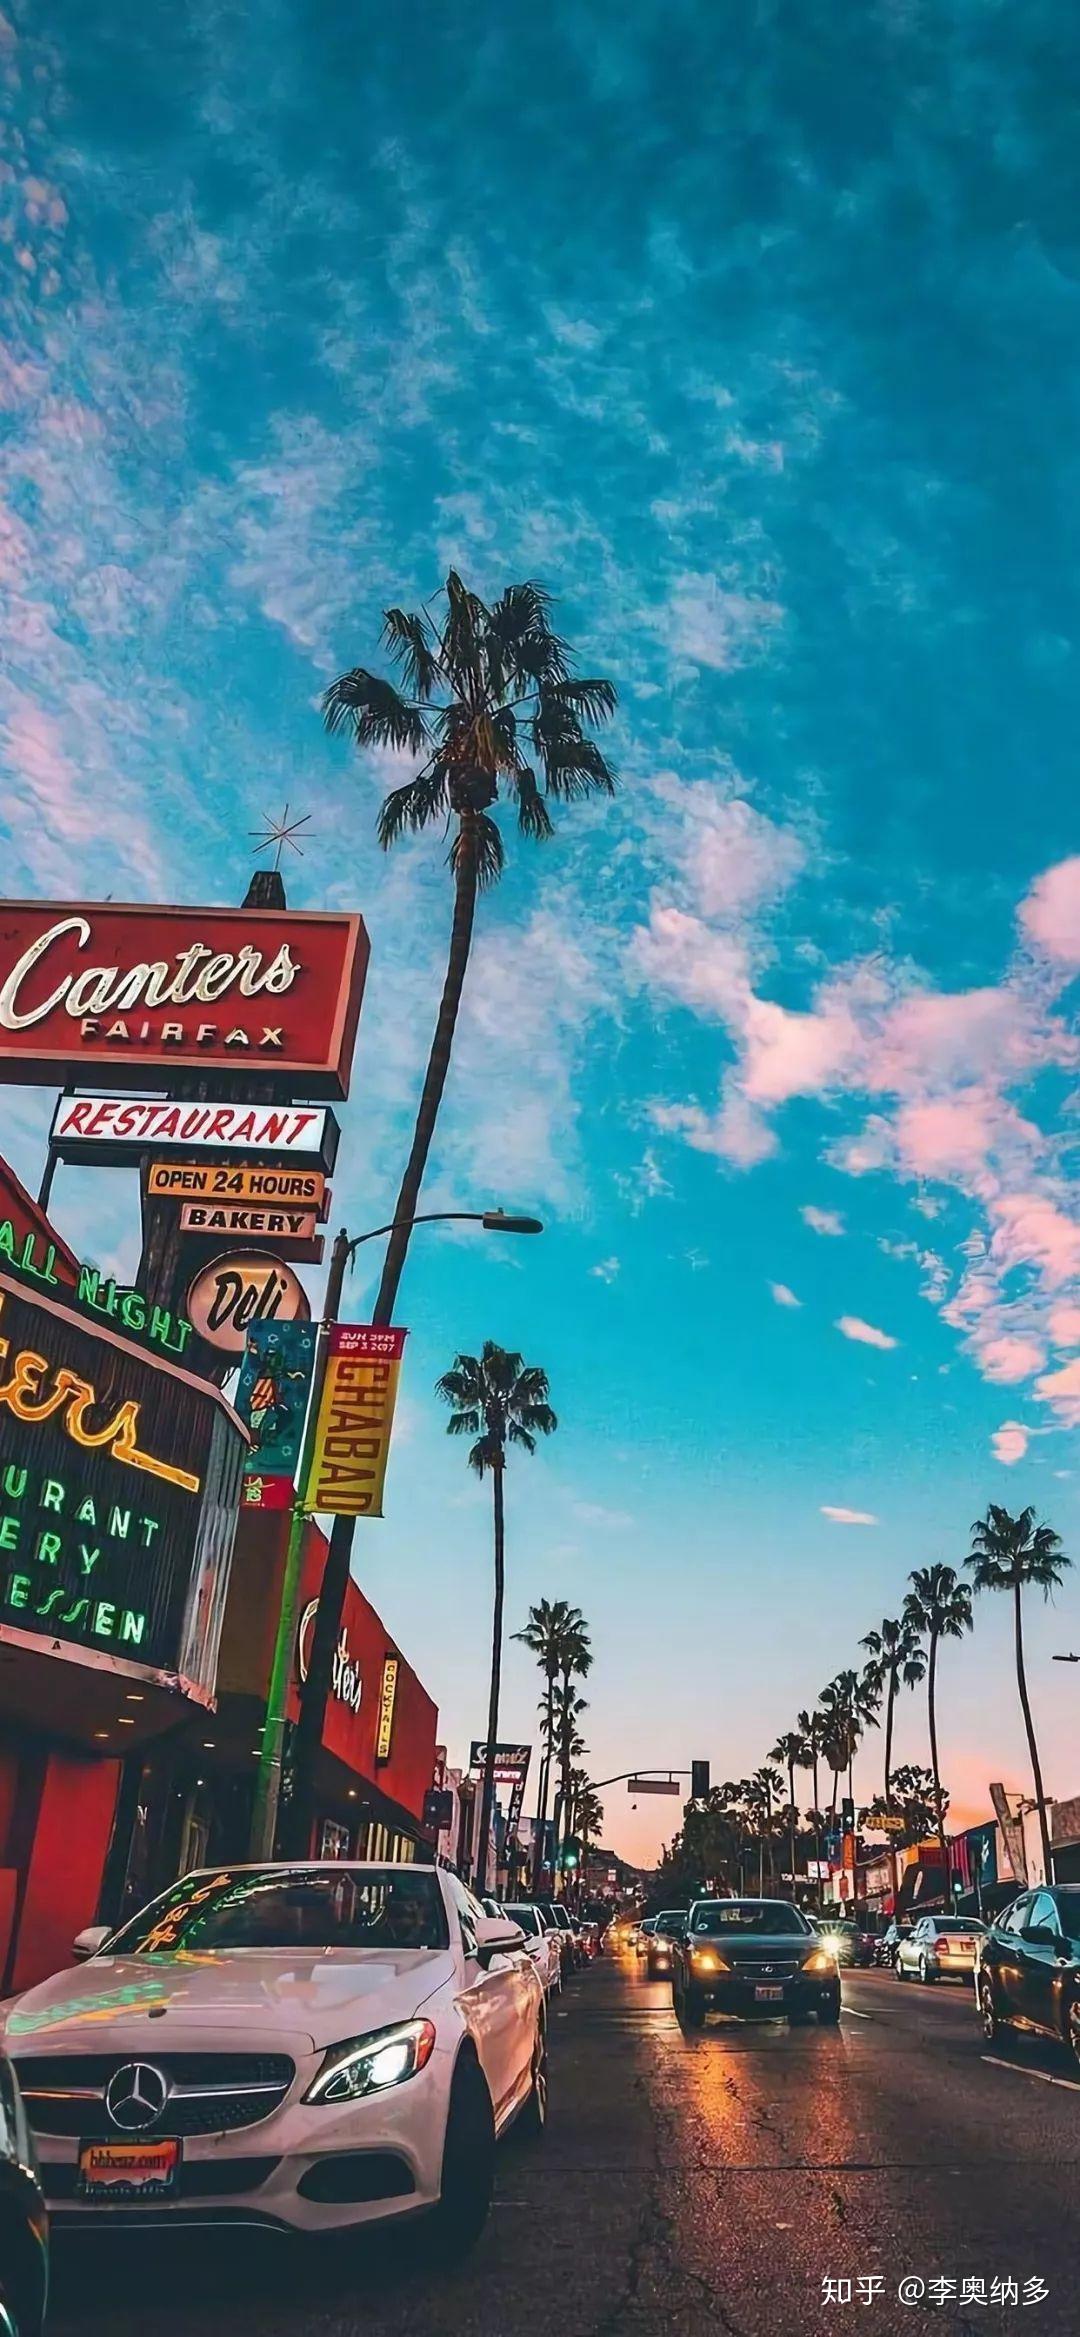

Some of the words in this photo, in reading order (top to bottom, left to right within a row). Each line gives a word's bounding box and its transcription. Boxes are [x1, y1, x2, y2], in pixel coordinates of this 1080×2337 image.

[0, 916, 301, 1030] Canters
[80, 1018, 284, 1048] FAIRFAX
[60, 1102, 320, 1145] RESTAURANT
[155, 1169, 208, 1190] OPEN
[212, 1170, 244, 1193] 24
[249, 1174, 316, 1197] HOURS
[188, 1210, 306, 1234] BAKERY
[0, 1220, 58, 1284] ALL
[78, 1266, 192, 1352] NIGHT
[207, 1269, 288, 1332] Deli
[316, 1360, 391, 1512] CHABAD
